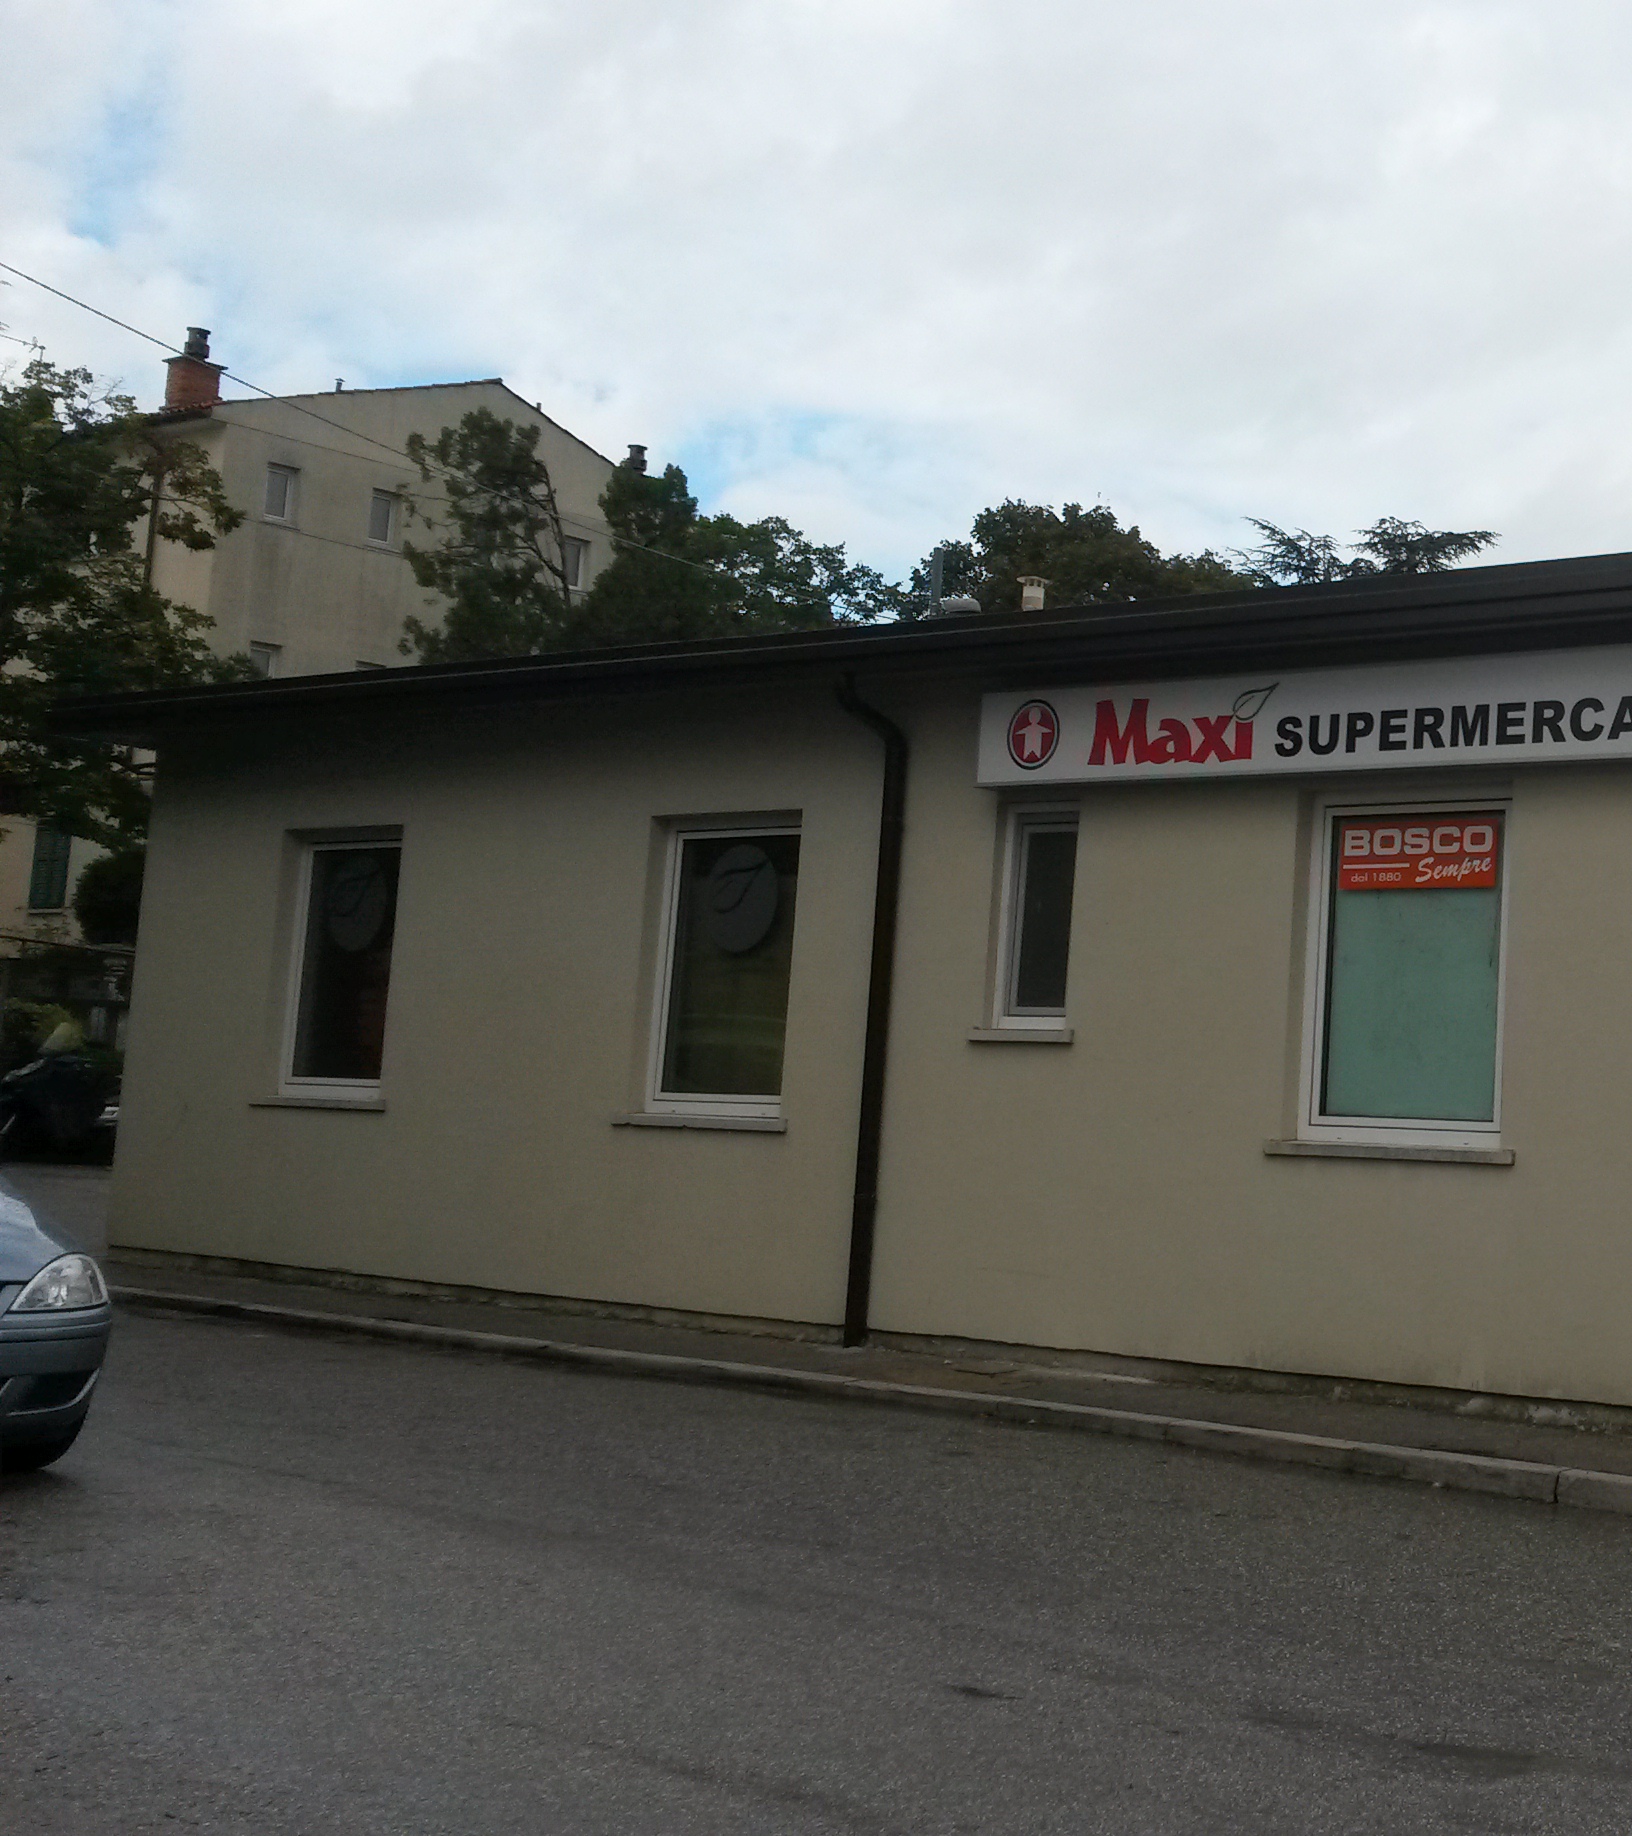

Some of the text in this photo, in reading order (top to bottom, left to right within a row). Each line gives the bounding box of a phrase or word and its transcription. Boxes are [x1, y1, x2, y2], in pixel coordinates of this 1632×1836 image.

[1087, 697, 1254, 765] Maxi
[1343, 825, 1494, 857] BOSCO
[1350, 872, 1402, 883] dal 1880
[1415, 856, 1492, 883] Sempre
